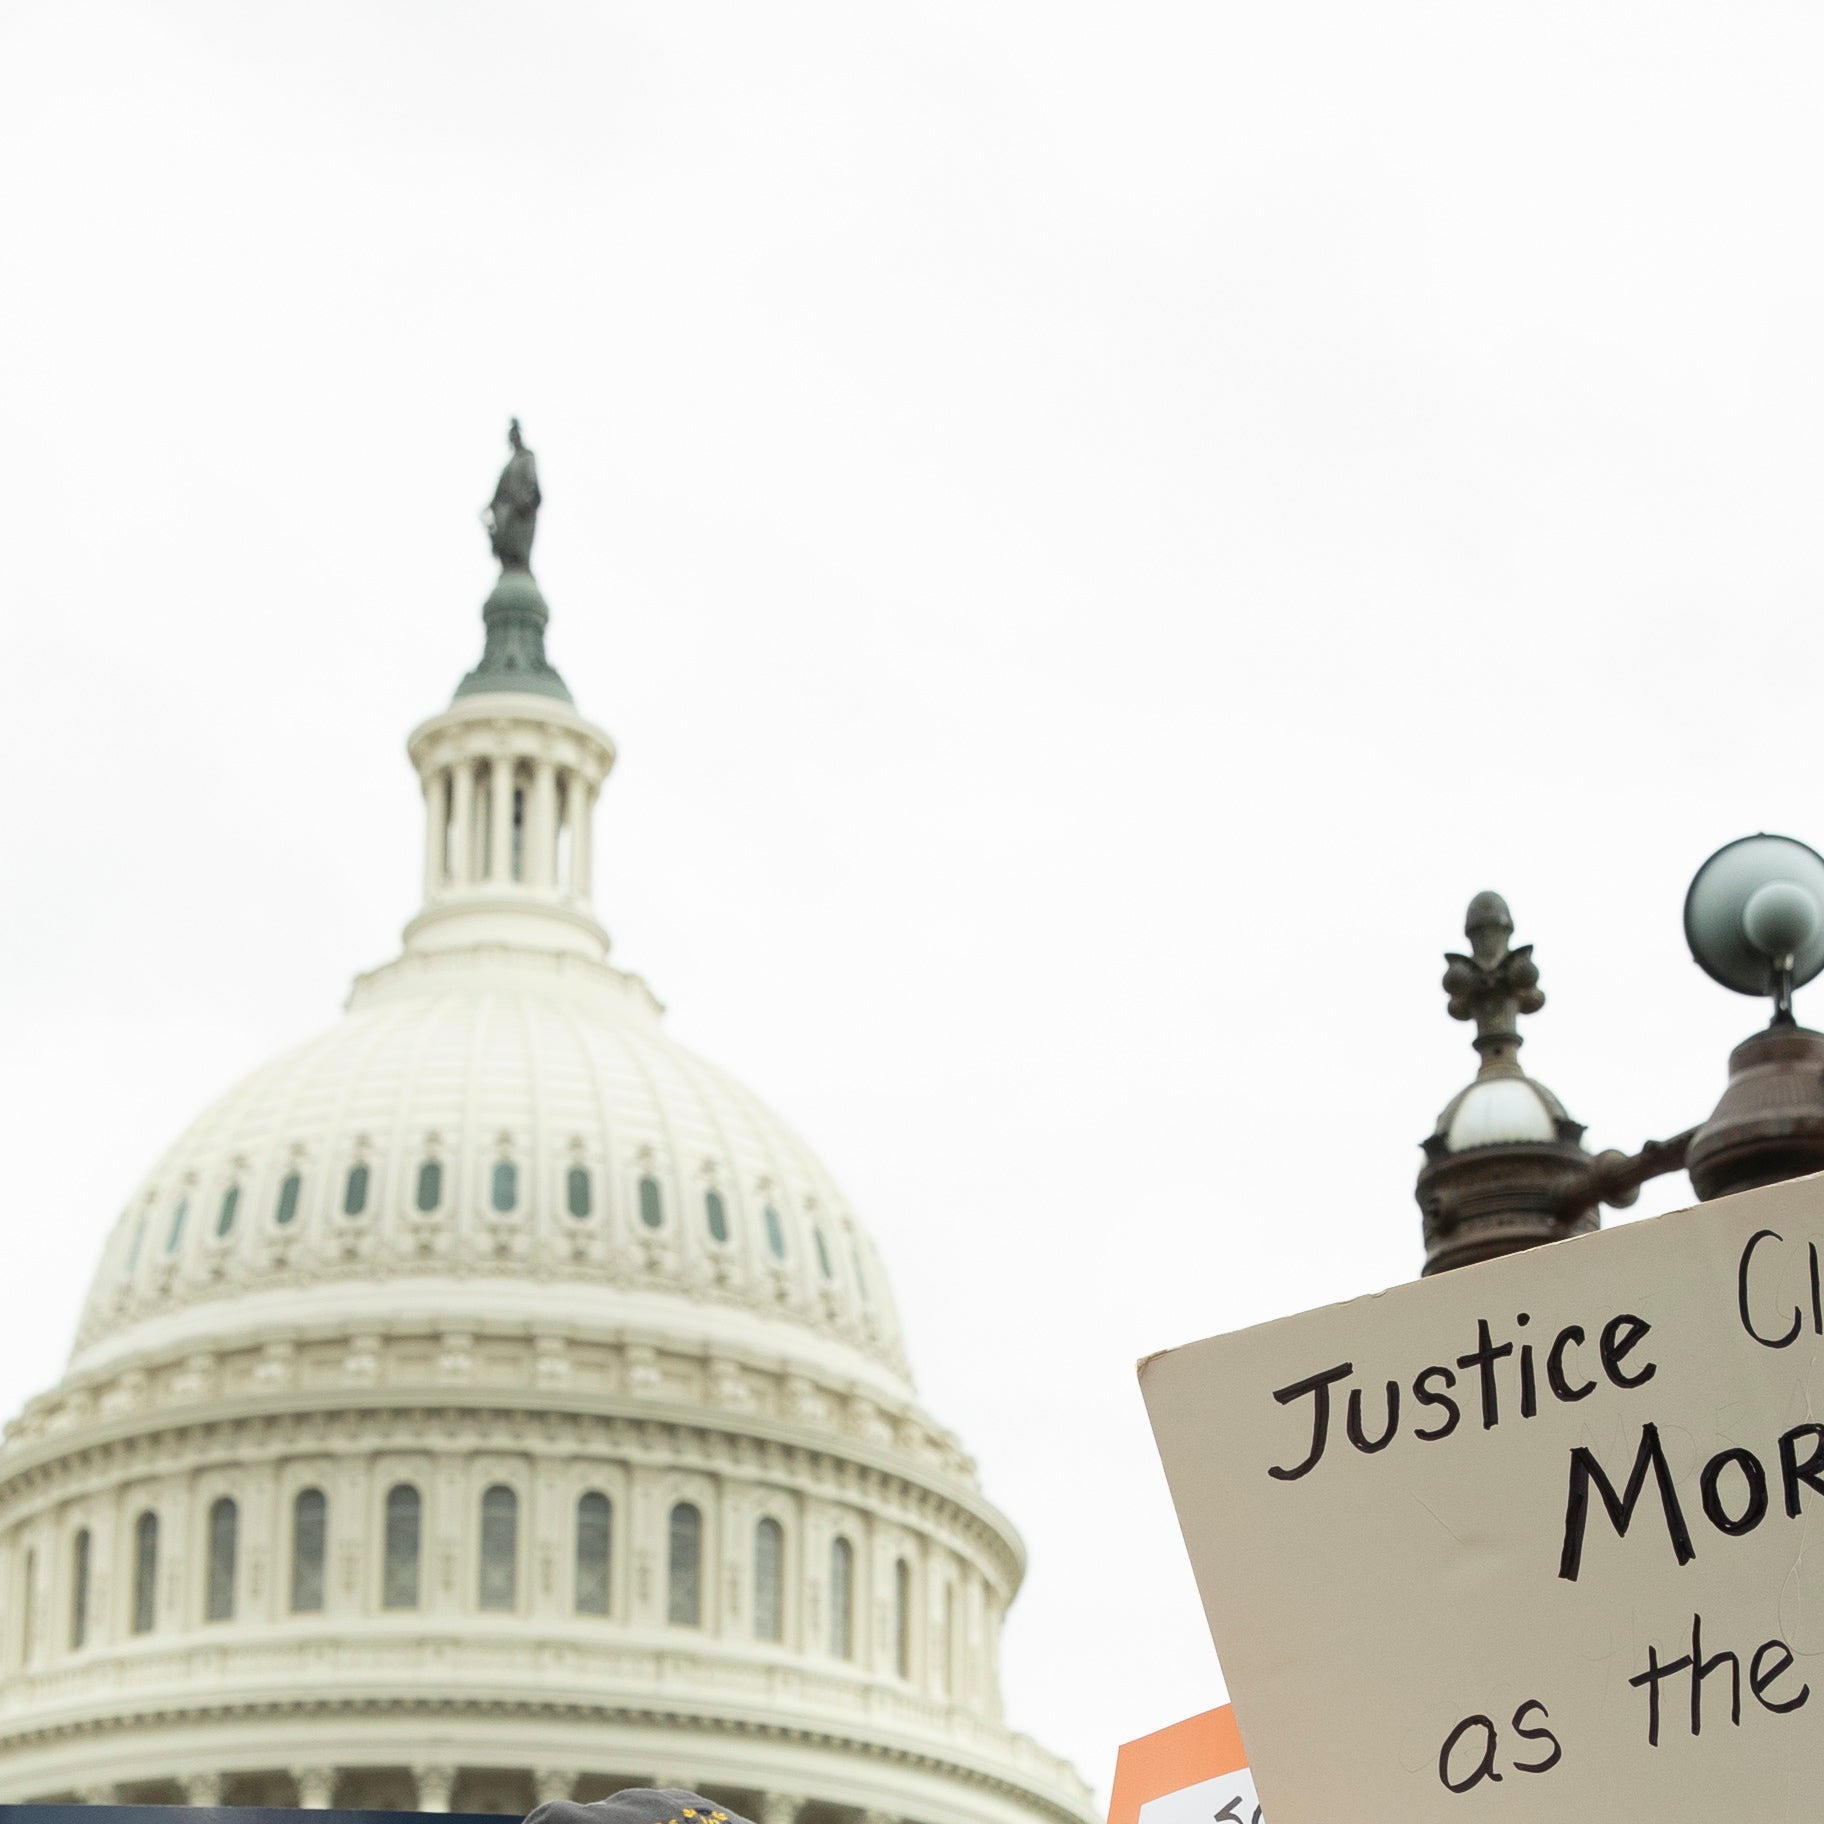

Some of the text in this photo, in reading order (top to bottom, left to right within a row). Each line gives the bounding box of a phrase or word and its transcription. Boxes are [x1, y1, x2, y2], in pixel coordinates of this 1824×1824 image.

[1268, 1310, 1656, 1483] Justice
[1437, 1697, 1562, 1796] as
[1629, 1615, 1811, 1749] the
